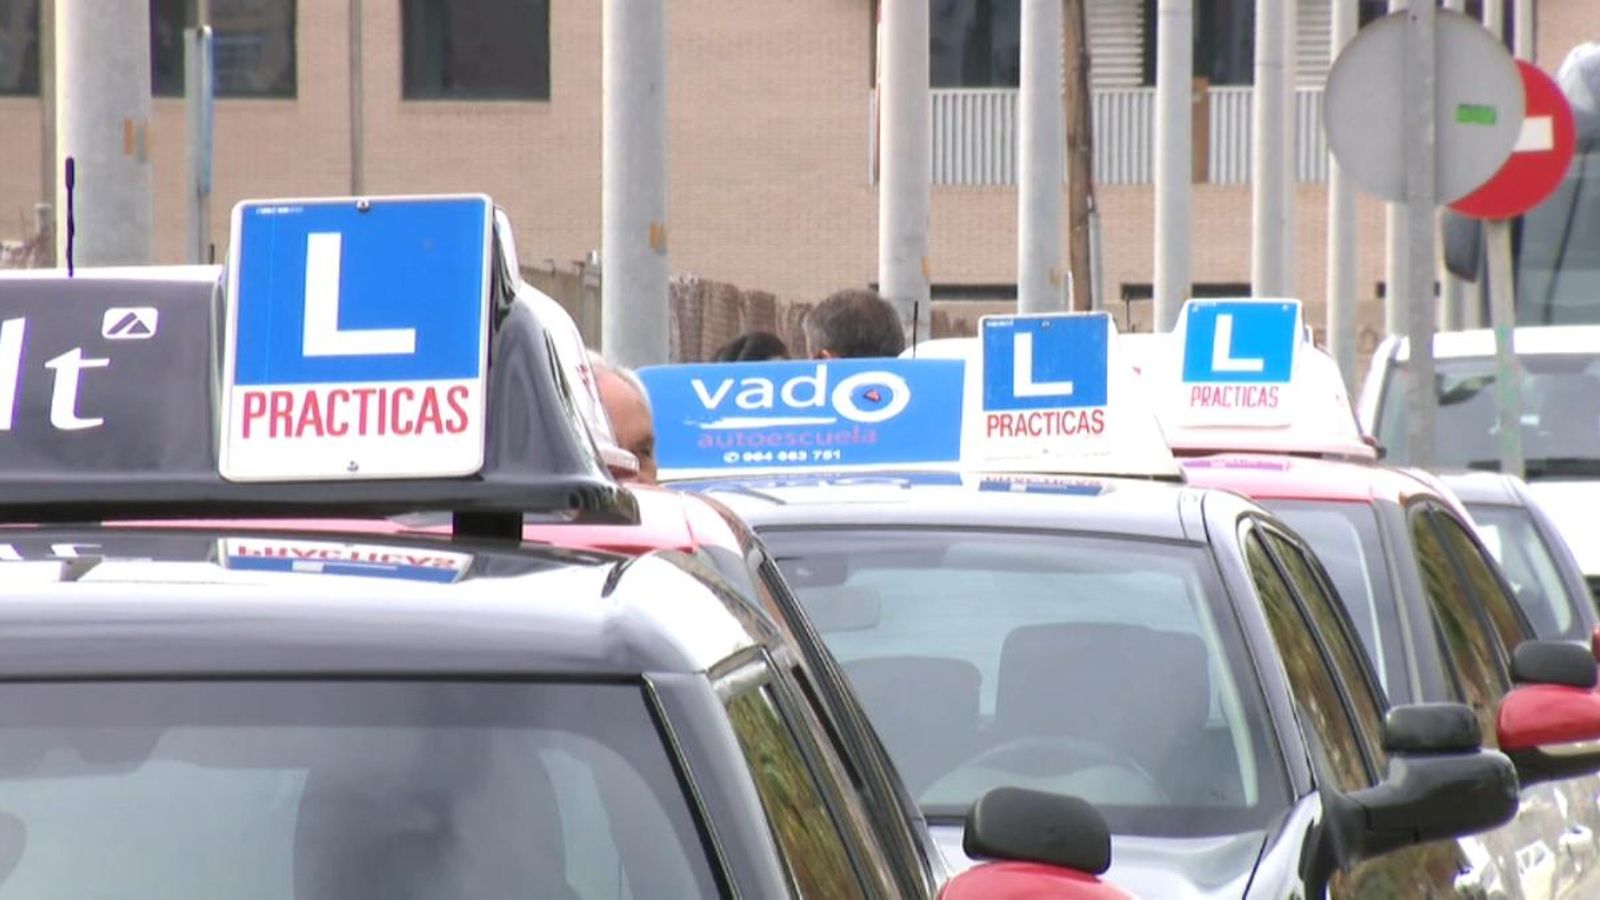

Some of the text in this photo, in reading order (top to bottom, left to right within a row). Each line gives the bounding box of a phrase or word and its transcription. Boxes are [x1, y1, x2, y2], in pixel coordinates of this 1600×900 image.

[302, 231, 416, 357] L
[1013, 331, 1074, 398] L
[1211, 313, 1265, 372] L
[241, 385, 470, 439] PRACTICAS
[986, 409, 1106, 438] PRACTICAS
[1190, 385, 1280, 409] PRACTICAS
[697, 425, 878, 450] autoescuela
